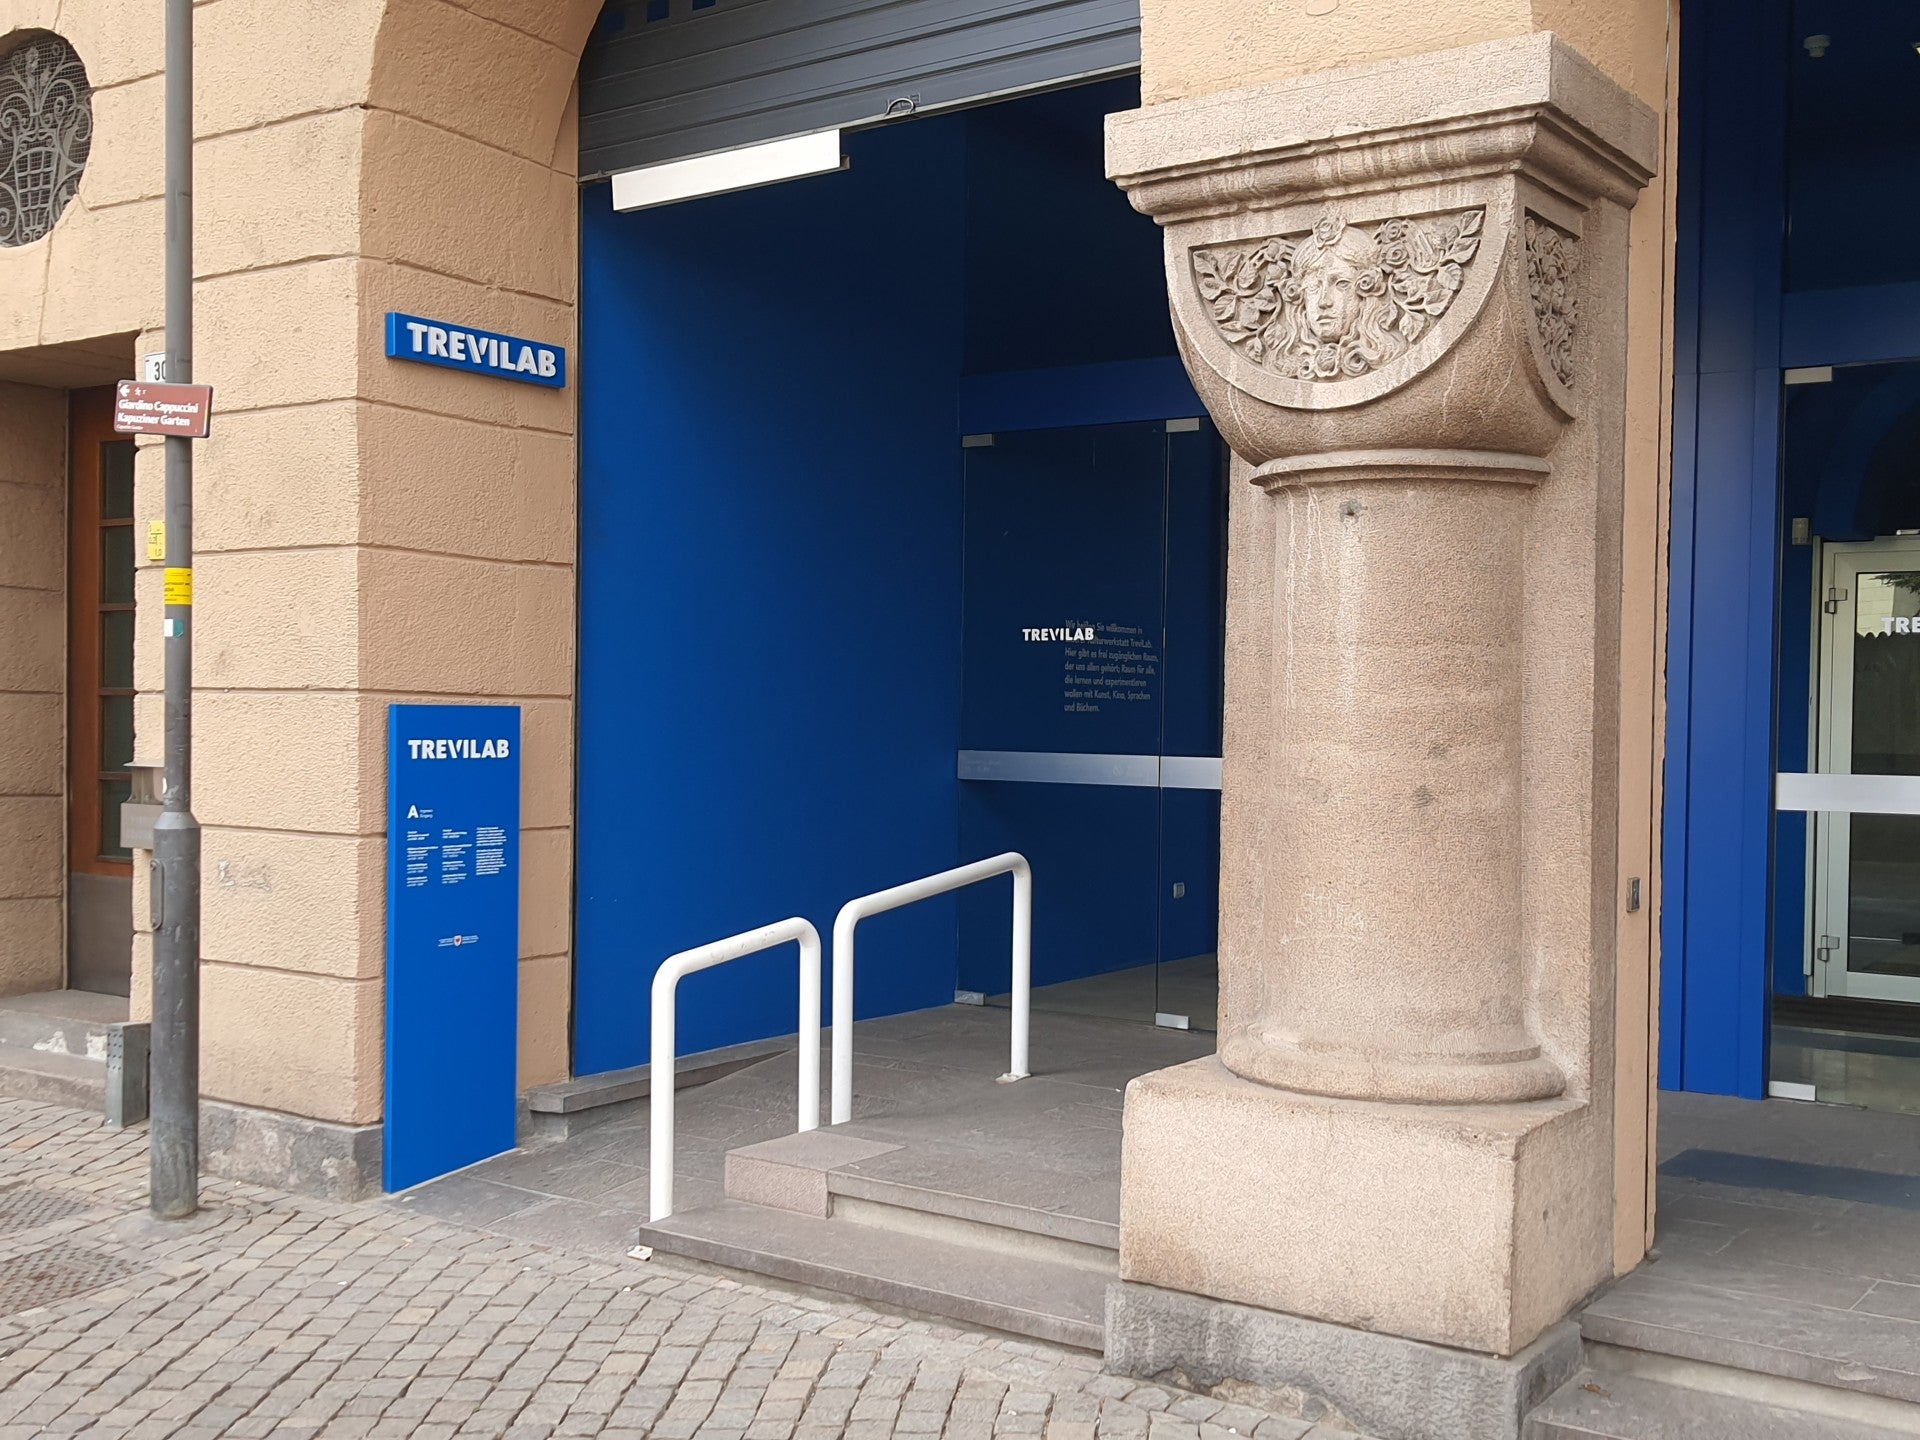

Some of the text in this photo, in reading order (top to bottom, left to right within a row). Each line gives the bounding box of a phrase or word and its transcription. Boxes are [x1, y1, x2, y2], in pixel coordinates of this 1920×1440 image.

[407, 322, 557, 378] TREVILAB
[118, 399, 199, 414] Giardino Cappuccini
[117, 412, 191, 427] Kapuziner Garten
[1022, 627, 1094, 642] TREVILAB
[1065, 647, 1077, 657] Hier
[1078, 648, 1090, 659] gibt
[1098, 649, 1108, 659] frei
[1065, 661, 1075, 670] der
[408, 739, 509, 759] TREVILAB
[407, 805, 419, 819] A
